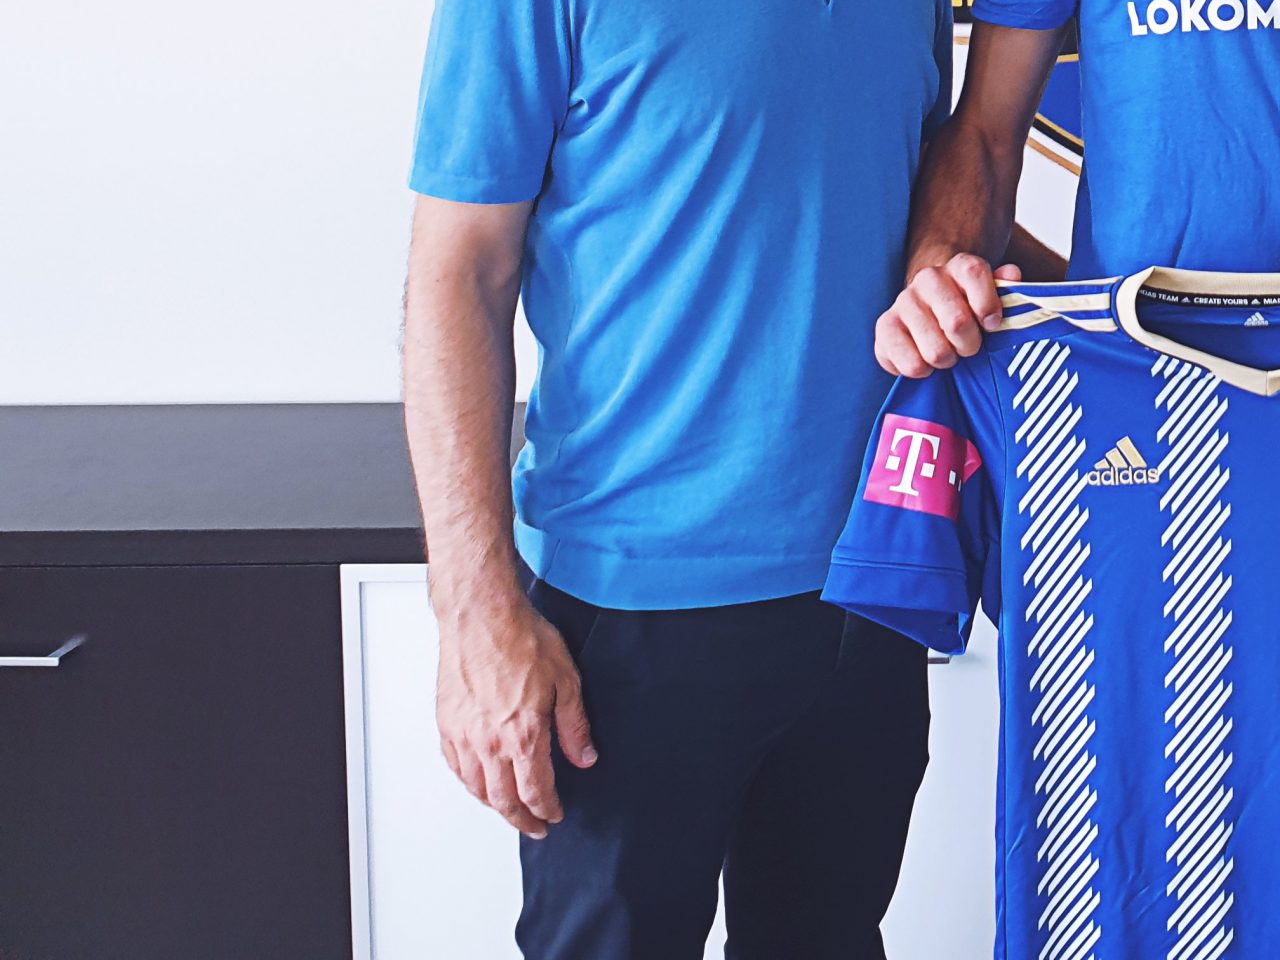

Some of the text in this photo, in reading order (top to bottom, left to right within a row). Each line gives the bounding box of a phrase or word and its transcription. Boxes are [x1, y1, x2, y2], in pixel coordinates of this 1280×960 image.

[1158, 293, 1179, 302] TEAM
[1193, 296, 1221, 305] CREATE
[1087, 465, 1160, 486] adidas
